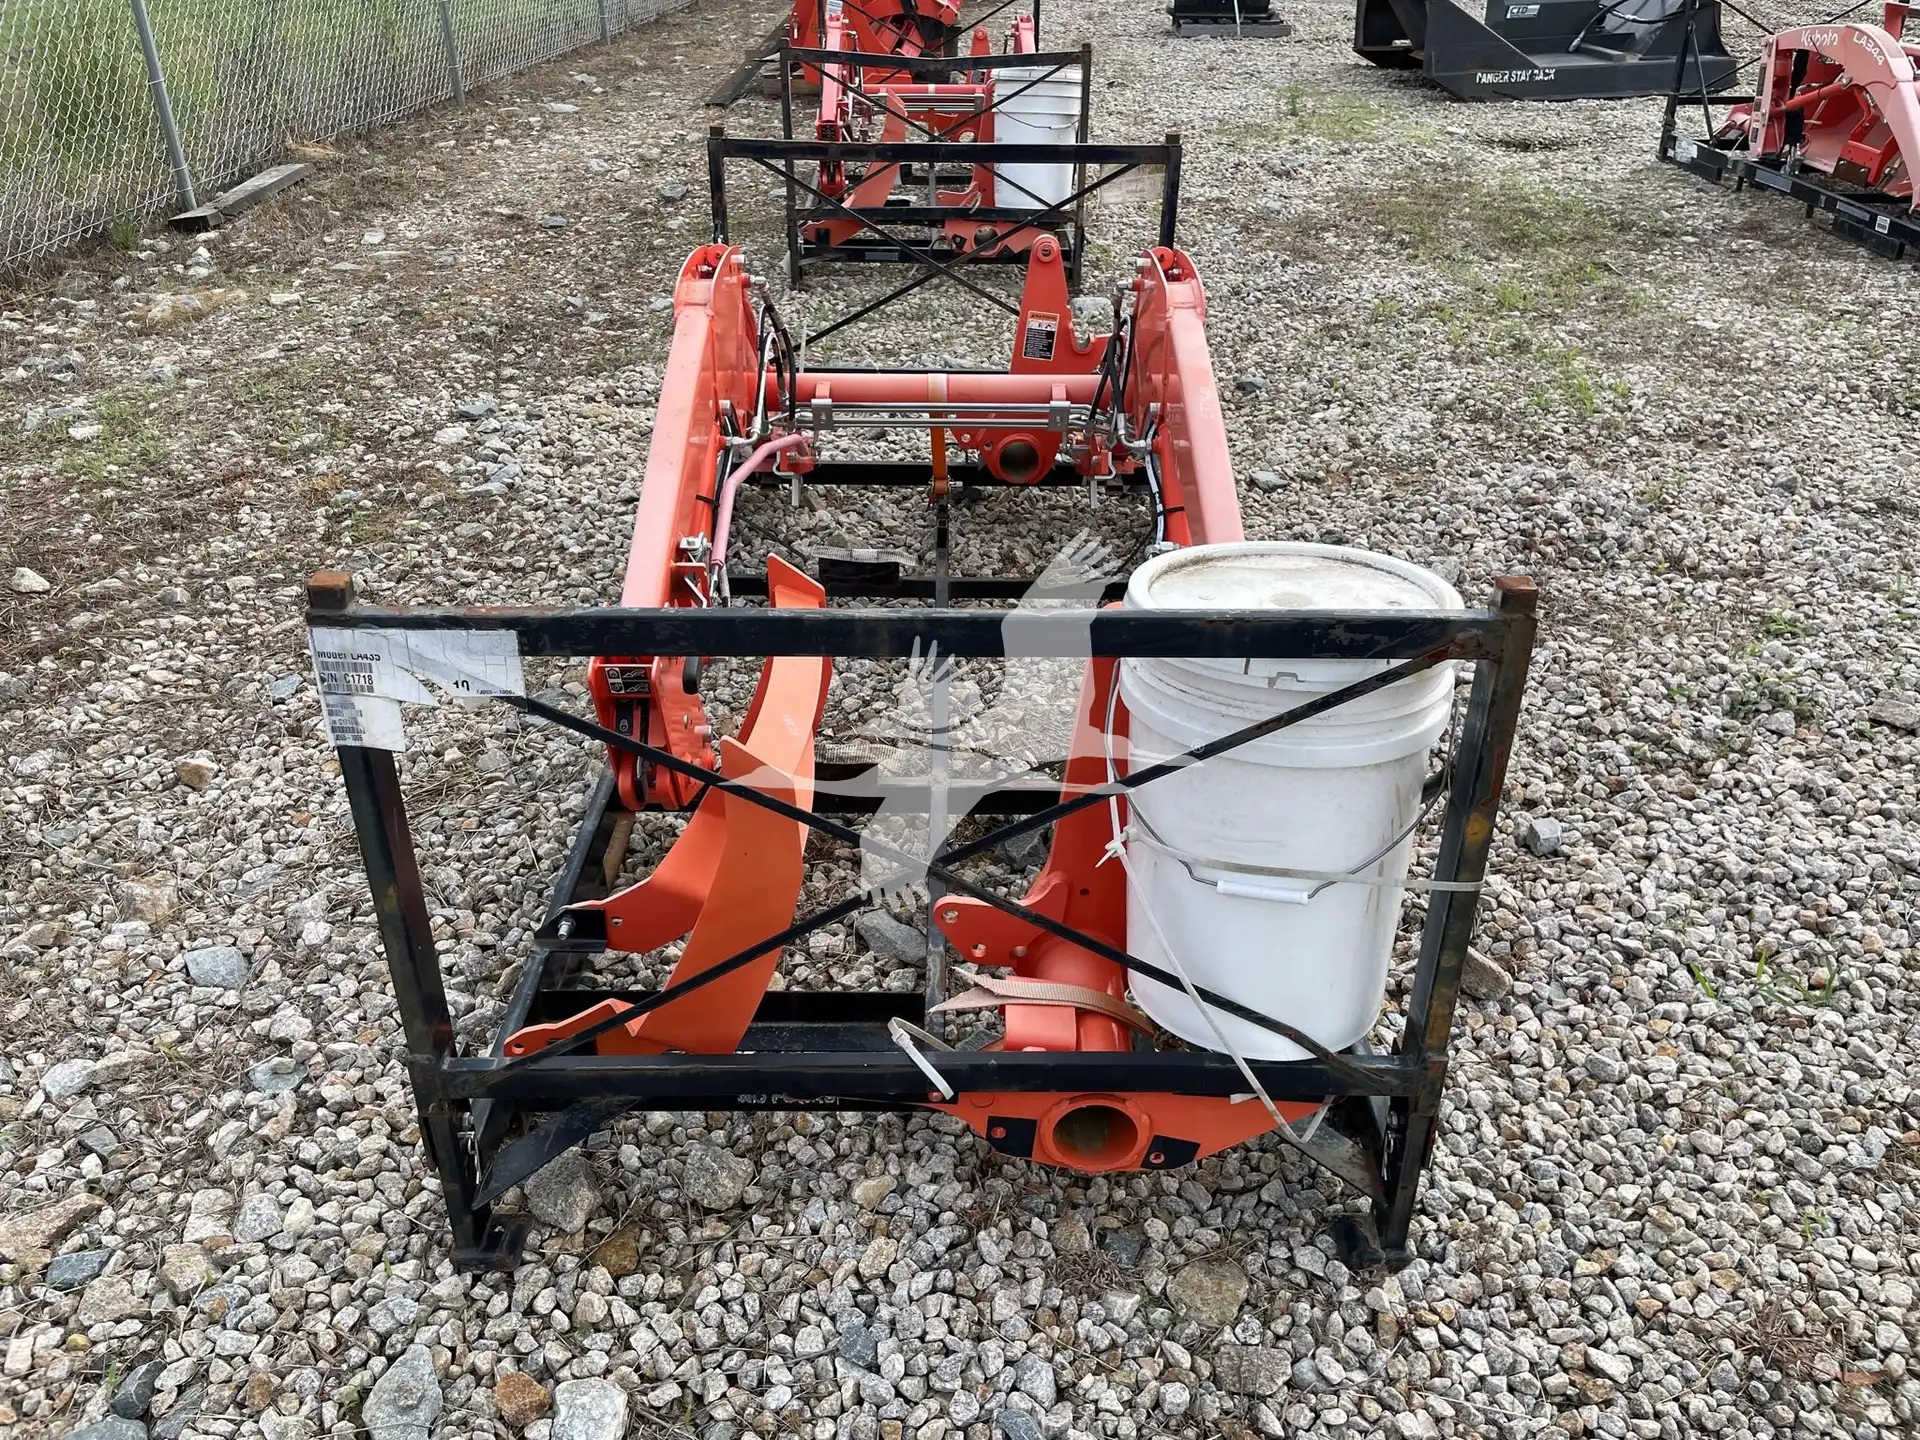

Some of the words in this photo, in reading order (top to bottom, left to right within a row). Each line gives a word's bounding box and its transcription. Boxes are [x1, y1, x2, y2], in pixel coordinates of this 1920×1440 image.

[1801, 29, 1838, 47] Kubota
[1853, 31, 1885, 66] LA344
[1510, 69, 1532, 82] STAY
[344, 673, 374, 685] C1718
